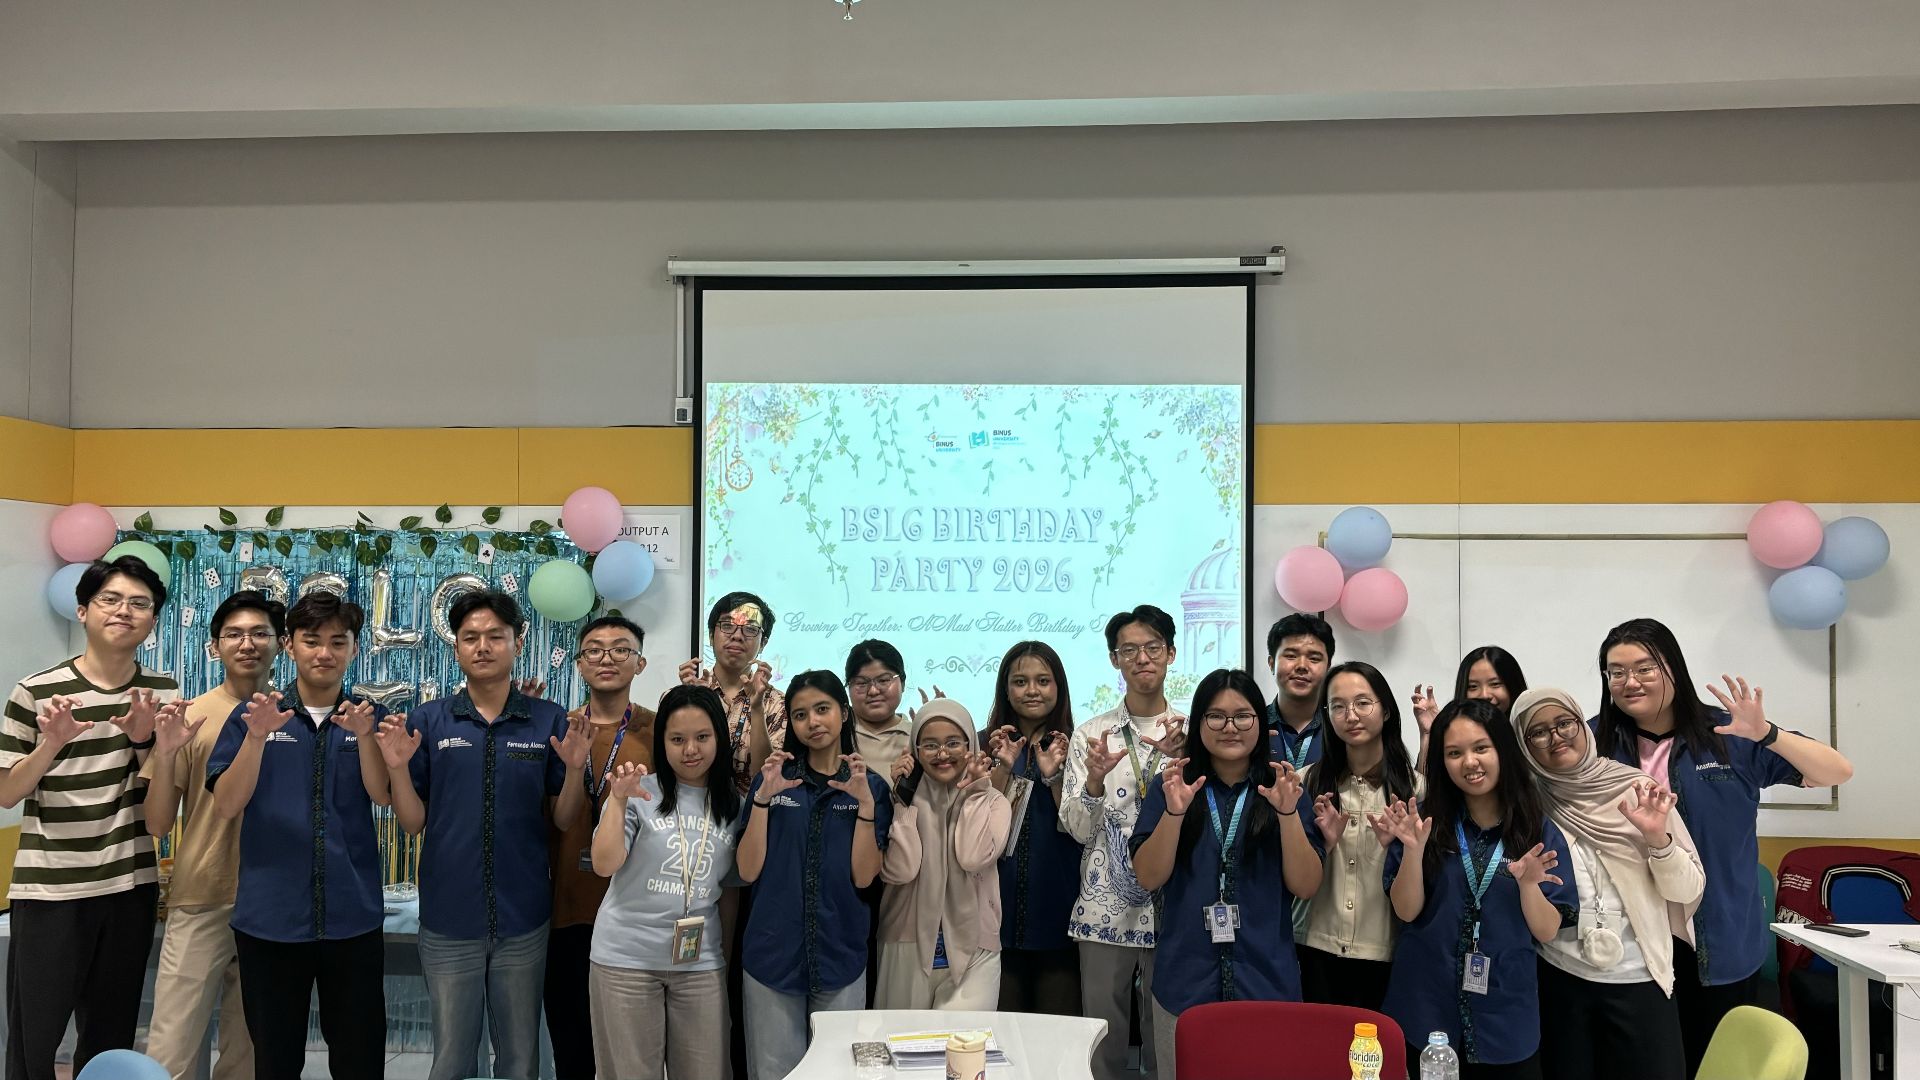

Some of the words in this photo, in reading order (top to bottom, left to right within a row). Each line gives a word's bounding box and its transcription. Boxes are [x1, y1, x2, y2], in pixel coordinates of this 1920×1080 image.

[661, 526, 669, 536] A
[932, 506, 1103, 543] BIRTHDAY
[871, 556, 985, 592] PARTY
[993, 556, 1074, 593] 2026
[784, 611, 839, 639] Growing
[842, 612, 903, 638] Together:
[975, 611, 1024, 632] Hatter
[1027, 612, 1086, 640] Birthday
[649, 816, 675, 831] LOS
[679, 815, 733, 845] ANGELES
[659, 833, 715, 882] 26
